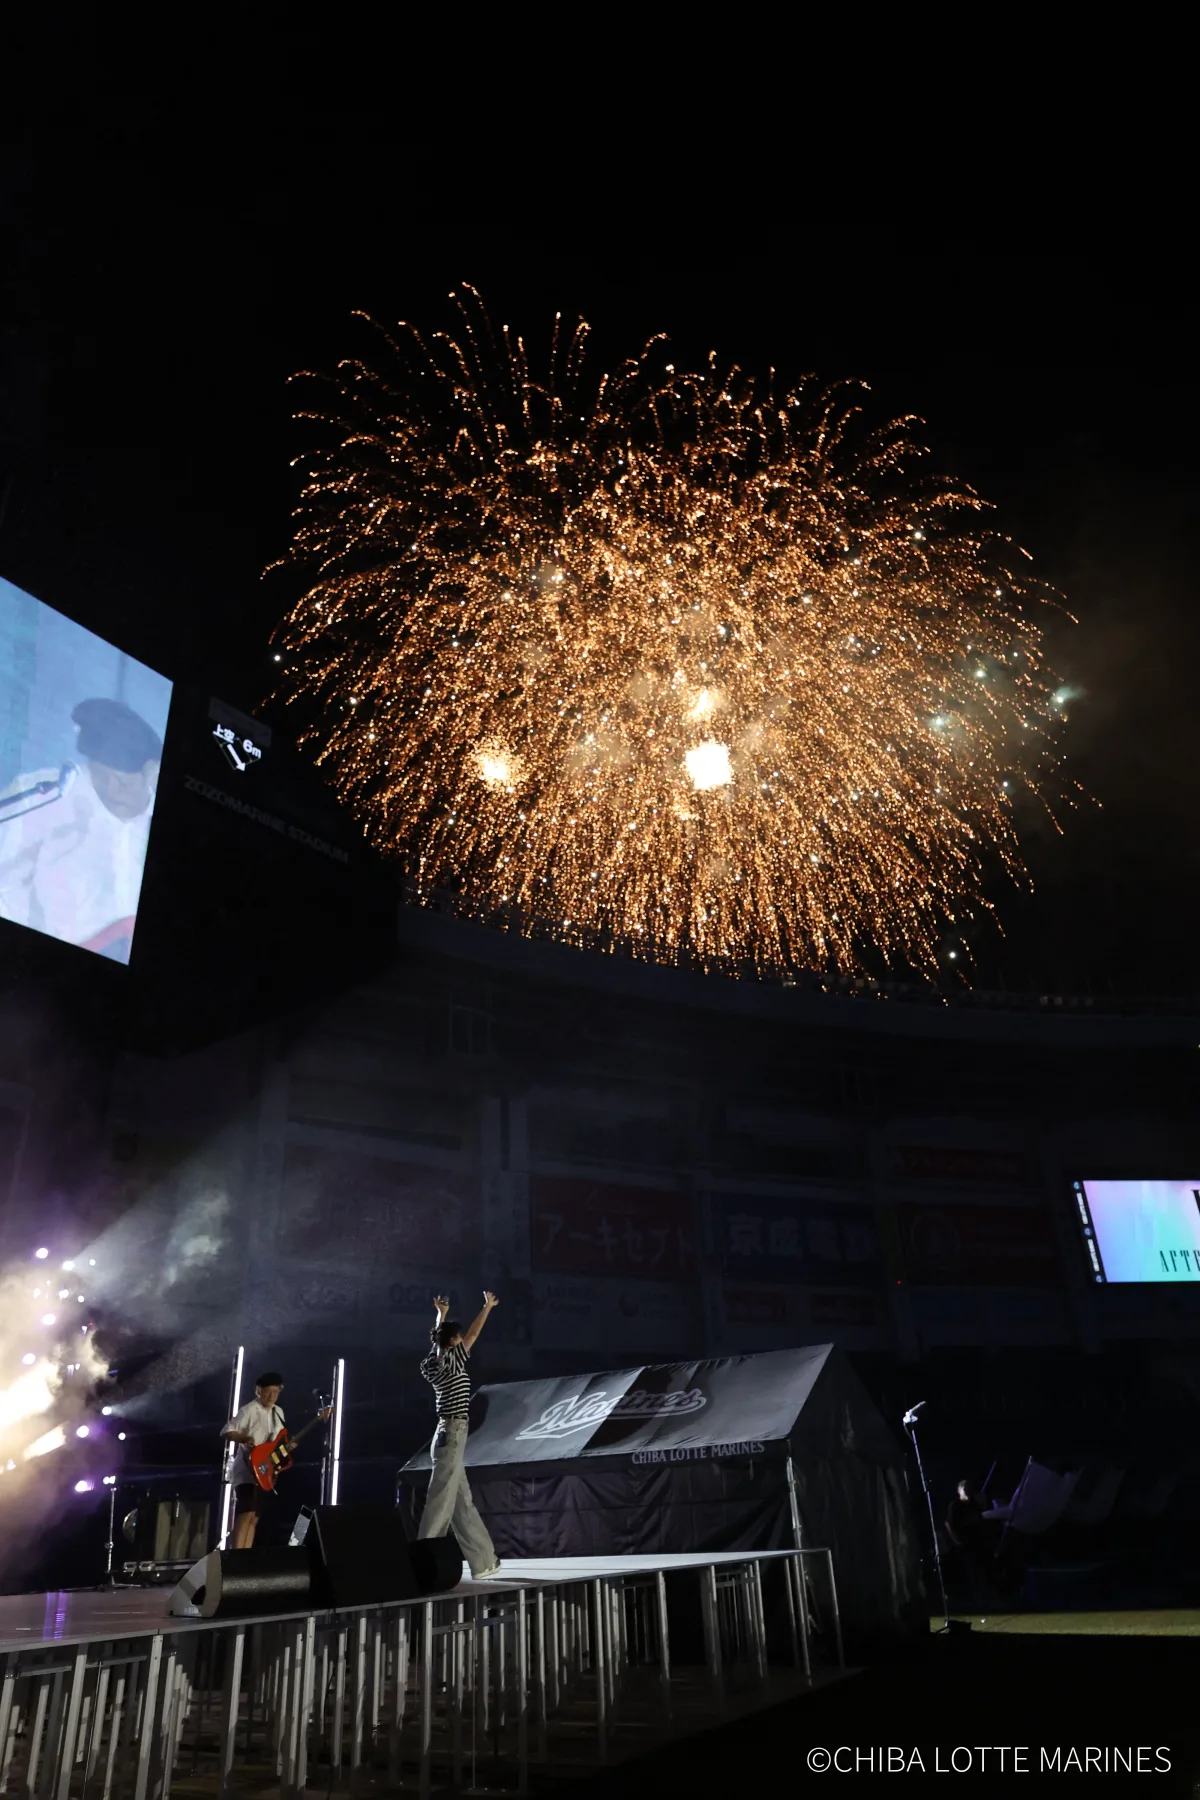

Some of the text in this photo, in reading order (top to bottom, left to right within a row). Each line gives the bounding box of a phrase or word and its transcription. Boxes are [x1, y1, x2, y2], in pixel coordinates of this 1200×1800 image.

[243, 739, 262, 759] 6m
[183, 774, 349, 864] ZOZOMARINE STADIUM
[515, 1388, 707, 1441] Marines
[632, 1441, 765, 1465] CHIBA LOTTE MARINES
